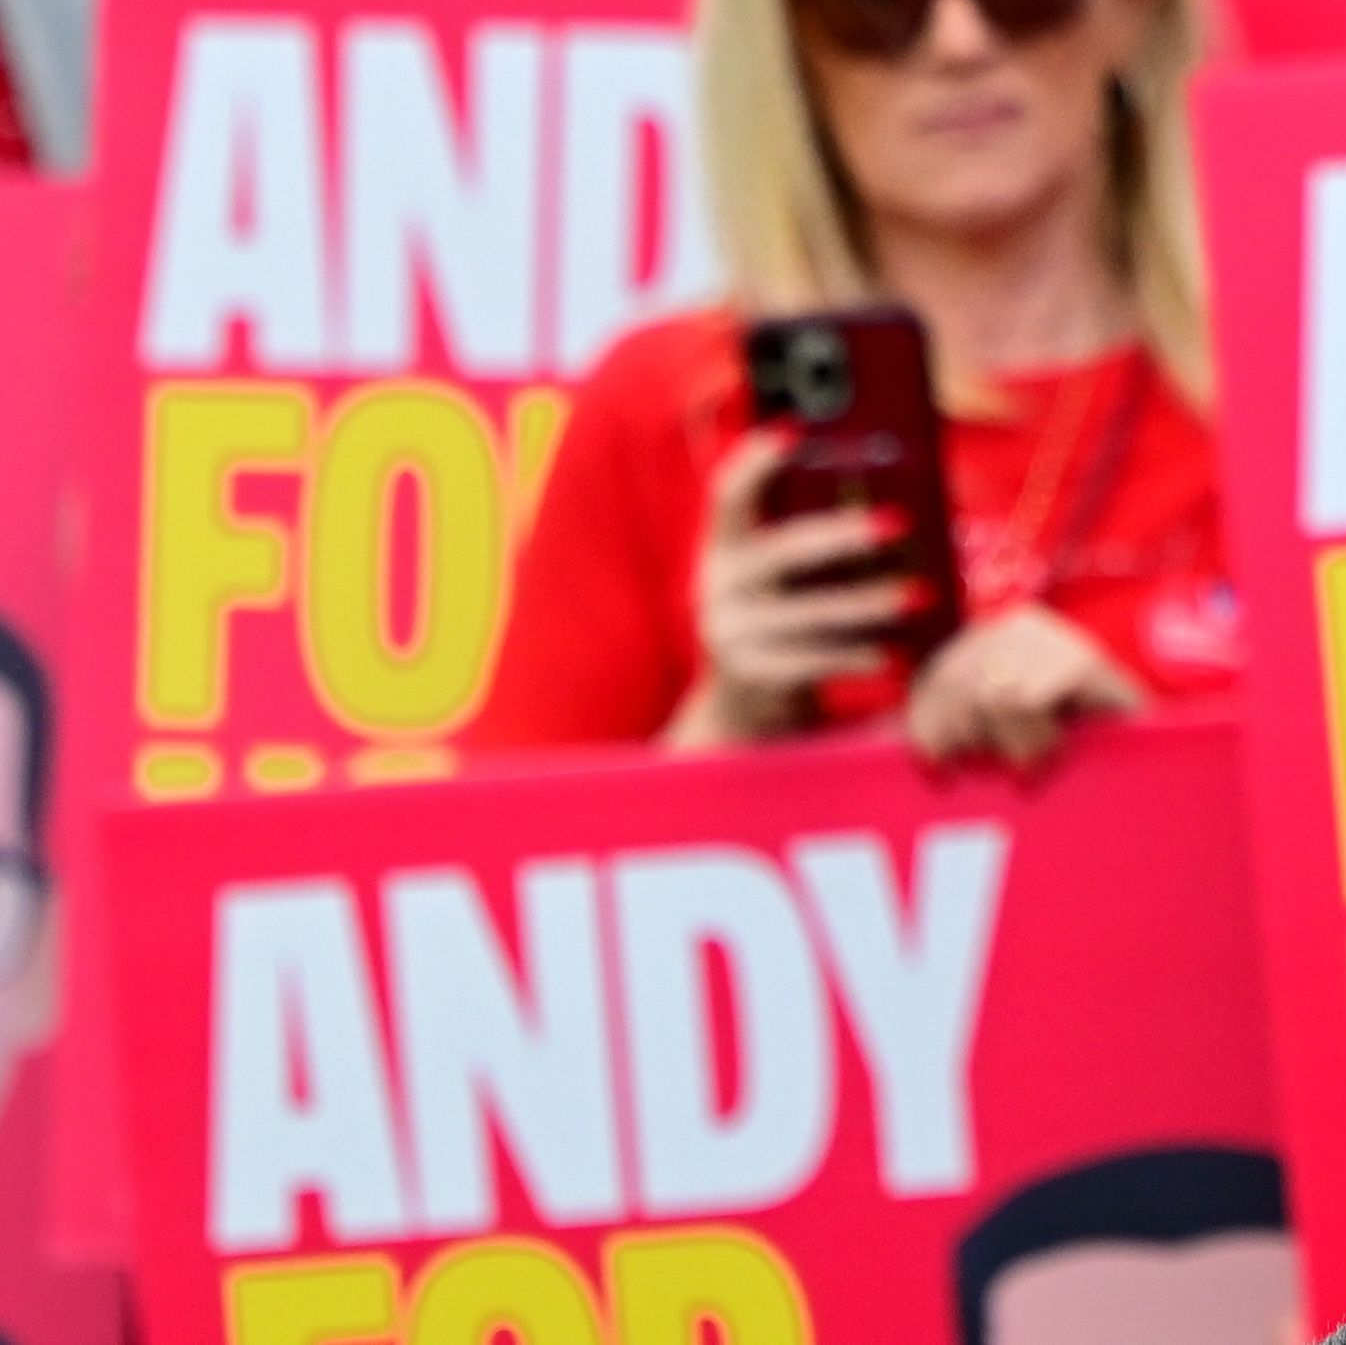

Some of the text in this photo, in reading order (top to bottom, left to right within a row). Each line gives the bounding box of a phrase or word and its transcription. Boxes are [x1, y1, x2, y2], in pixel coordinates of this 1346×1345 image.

[140, 16, 724, 378] AND
[138, 376, 572, 746] FO
[208, 819, 1012, 1252] ANDY
